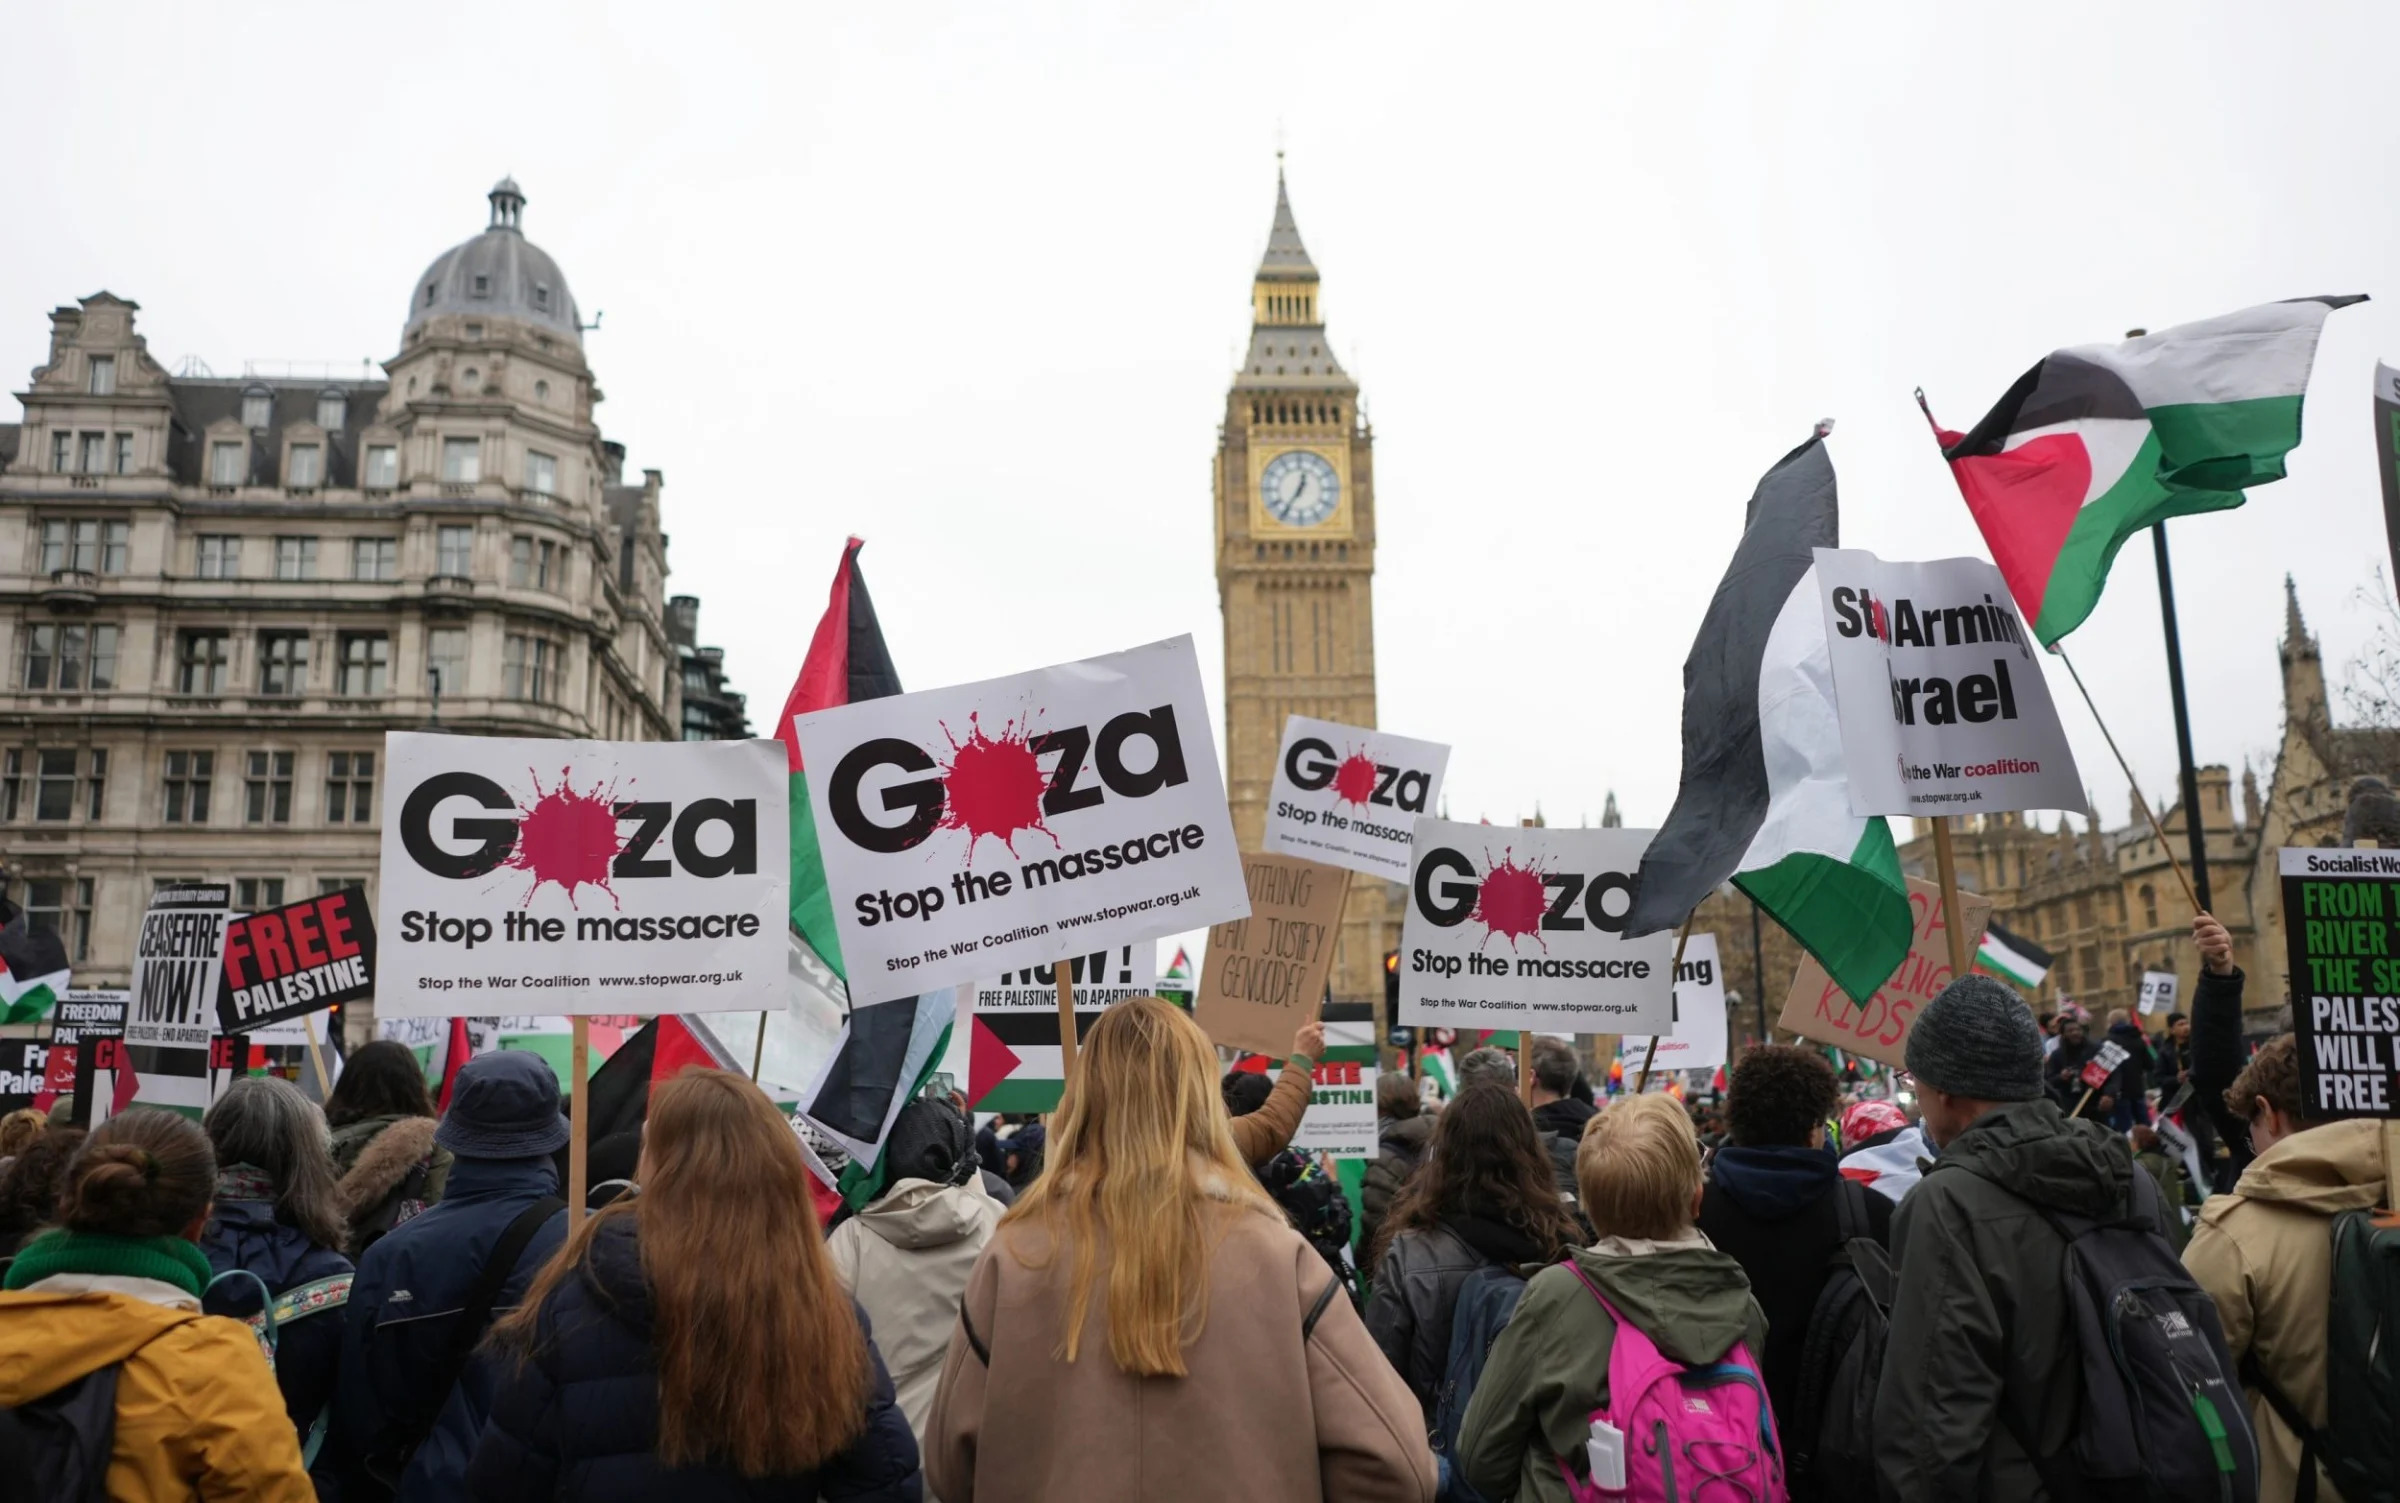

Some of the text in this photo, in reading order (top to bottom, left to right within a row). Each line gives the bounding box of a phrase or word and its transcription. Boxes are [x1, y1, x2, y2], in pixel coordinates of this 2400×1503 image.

[1832, 586, 1892, 648] St
[828, 702, 1189, 854] Gza
[1284, 737, 1432, 814] Gza
[1912, 764, 1931, 780] the
[1933, 763, 1961, 779] War
[1964, 757, 2040, 778] coalition
[400, 770, 758, 880] Gza
[1277, 801, 1317, 826] Stop
[1322, 809, 1348, 830] the
[855, 823, 1205, 927] Stop the massacre
[2307, 854, 2380, 873] Socialist
[1247, 863, 1314, 908] OTHING
[1414, 847, 1642, 933] Gza
[2302, 882, 2384, 917] FROM
[140, 913, 224, 958] CEASEFIRE
[223, 893, 361, 990] FREE
[401, 910, 760, 950] Stop the massacre
[886, 885, 1201, 972] Stop the War Coalition www.stopwar.org.uk
[2305, 920, 2389, 955] RIVER
[418, 969, 743, 991] Stop the War Coalition www.stopwar.org.uk
[1412, 948, 1651, 979] Stop the massacre
[2307, 958, 2363, 993] THE
[232, 955, 369, 1020] PALESTINE
[979, 989, 1002, 1007] FREE
[1004, 989, 1056, 1007] PALESTINE
[1073, 988, 1088, 1006] ND
[60, 1003, 123, 1021] FREEDOM
[1420, 997, 1638, 1015] Stop the War Coalition www.stopwar.org.uk
[1815, 978, 1915, 1046] KIDS
[2311, 996, 2400, 1032] PALES
[162, 1028, 176, 1042] END
[1656, 1042, 1690, 1052] oalition
[2313, 1035, 2386, 1071] WILL
[23, 1044, 50, 1068] Fr
[1309, 1090, 1373, 1106] ESTINE
[2318, 1073, 2390, 1110] FREE
